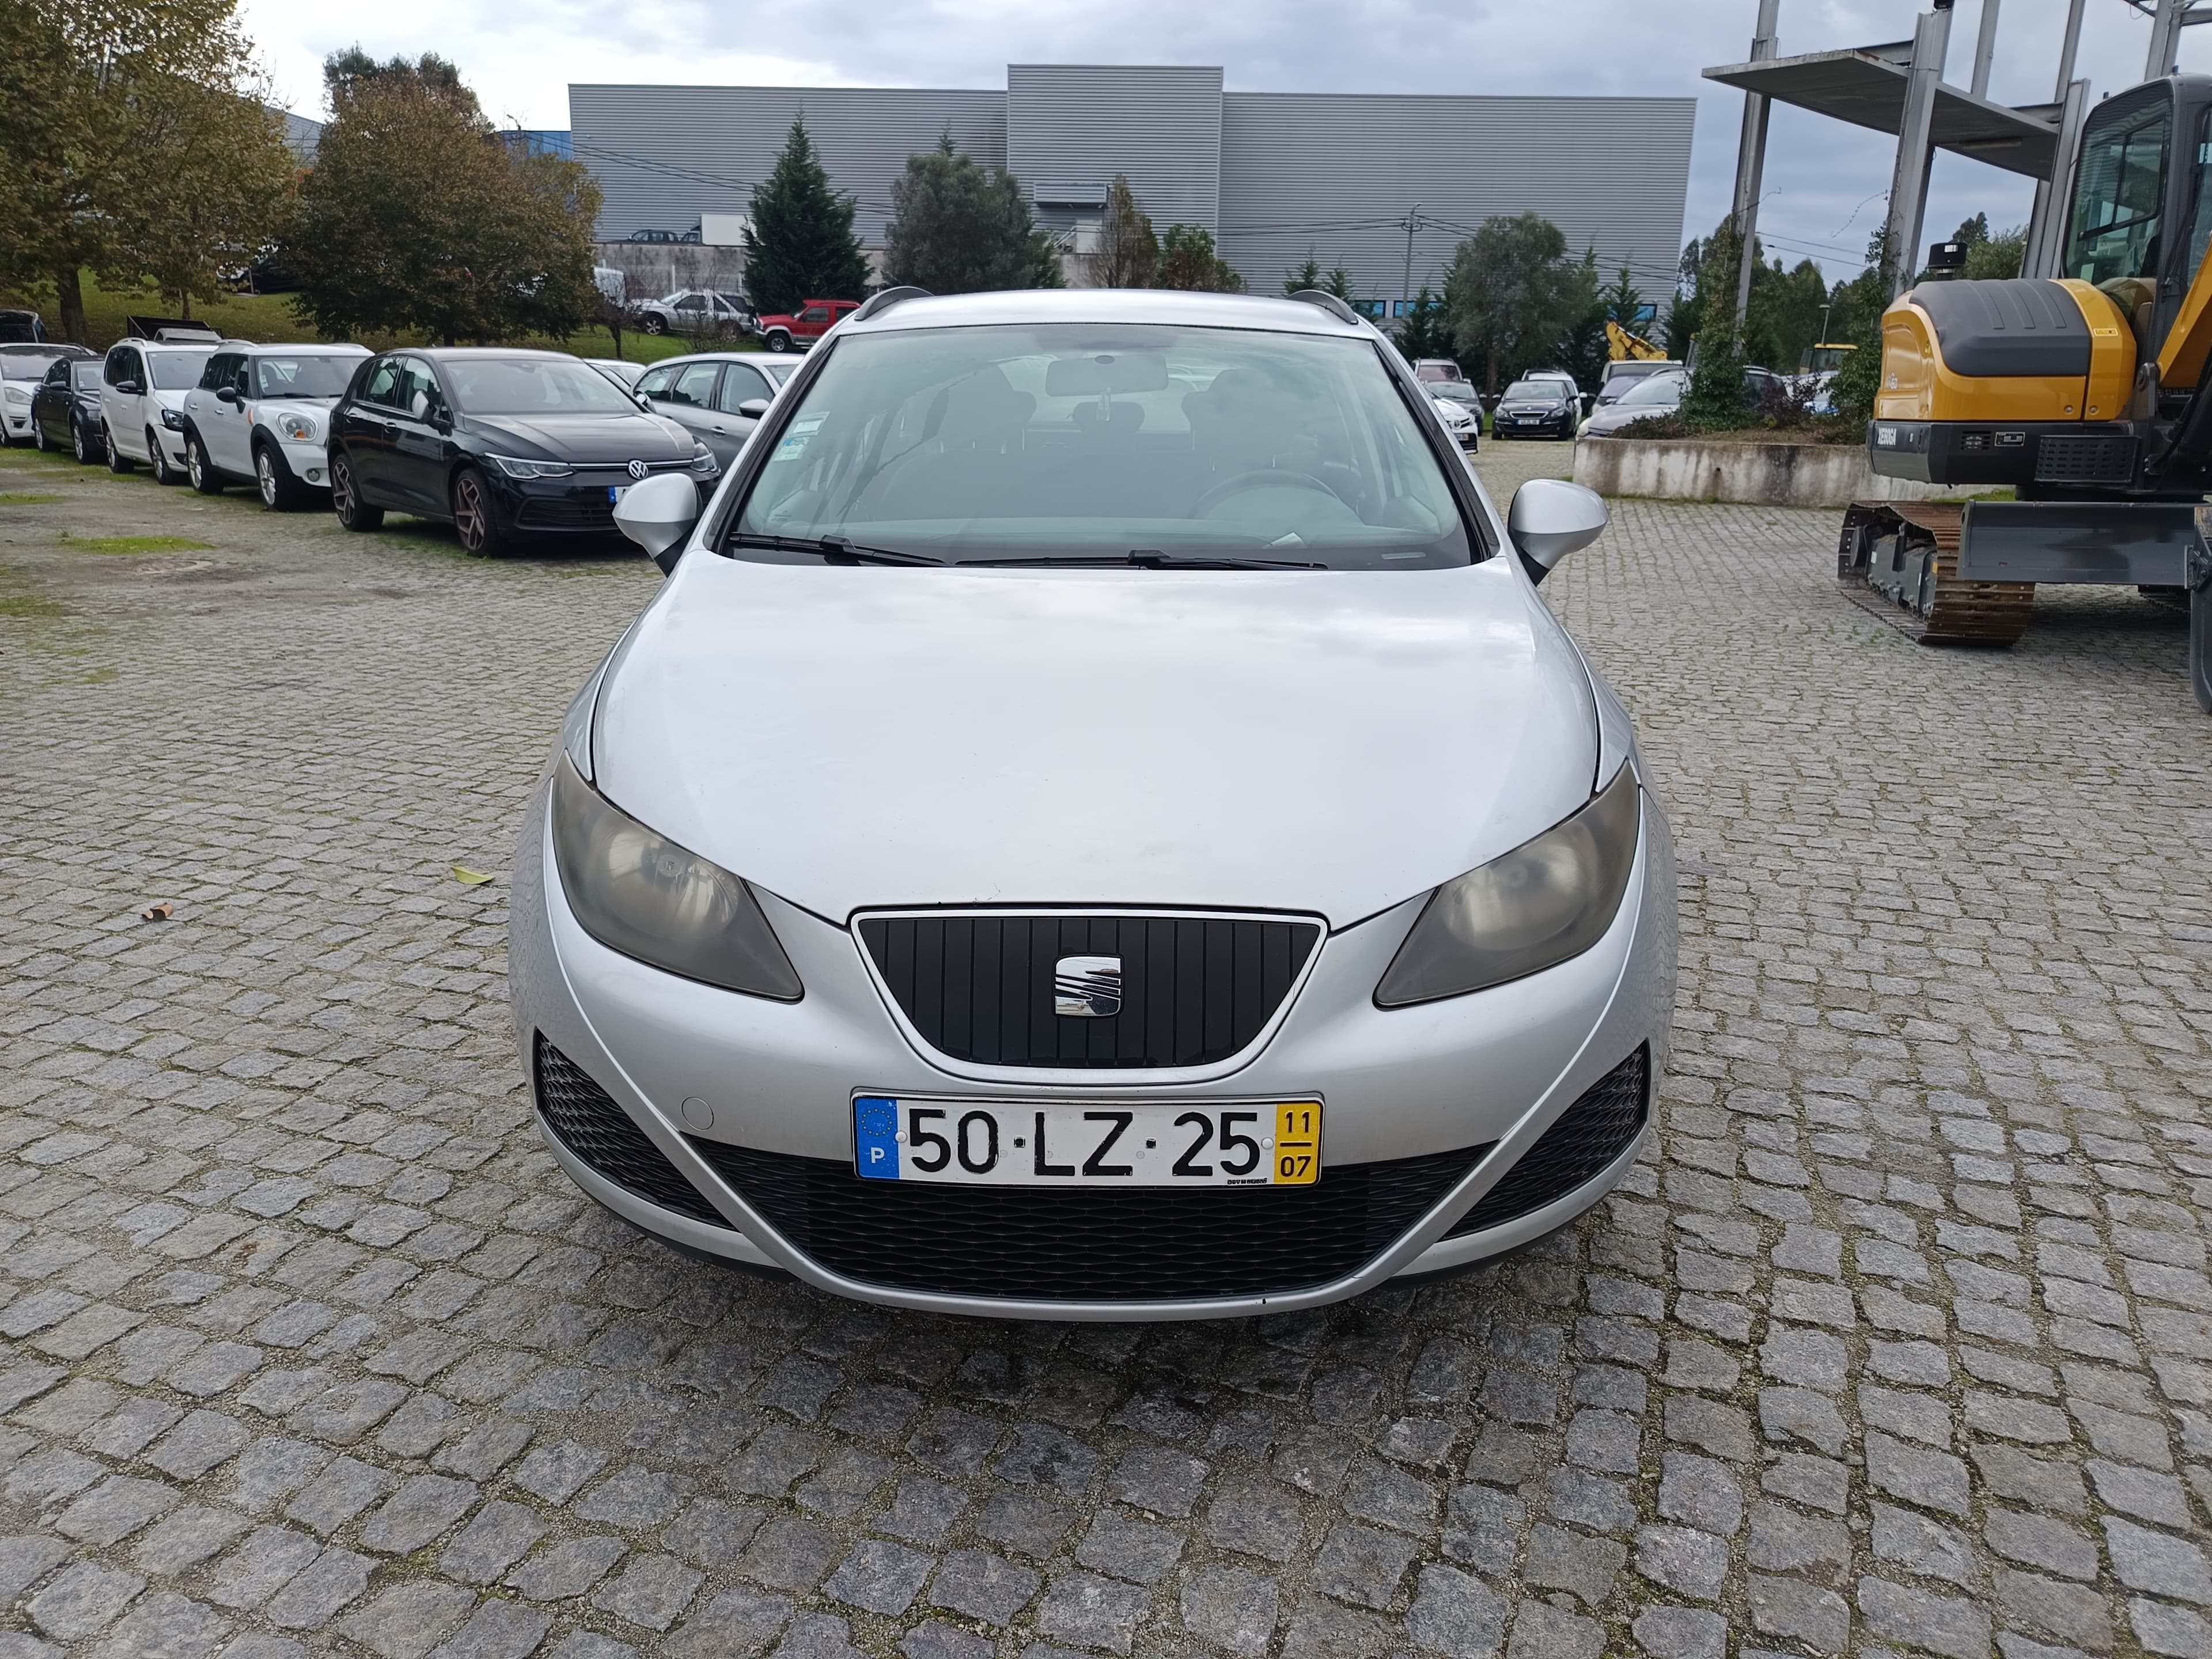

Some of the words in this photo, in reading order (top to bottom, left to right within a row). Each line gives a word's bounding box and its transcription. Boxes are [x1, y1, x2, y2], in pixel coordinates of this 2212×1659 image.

[1286, 1112, 1309, 1133] 11
[870, 1147, 885, 1164] P
[1281, 1156, 1312, 1177] 07
